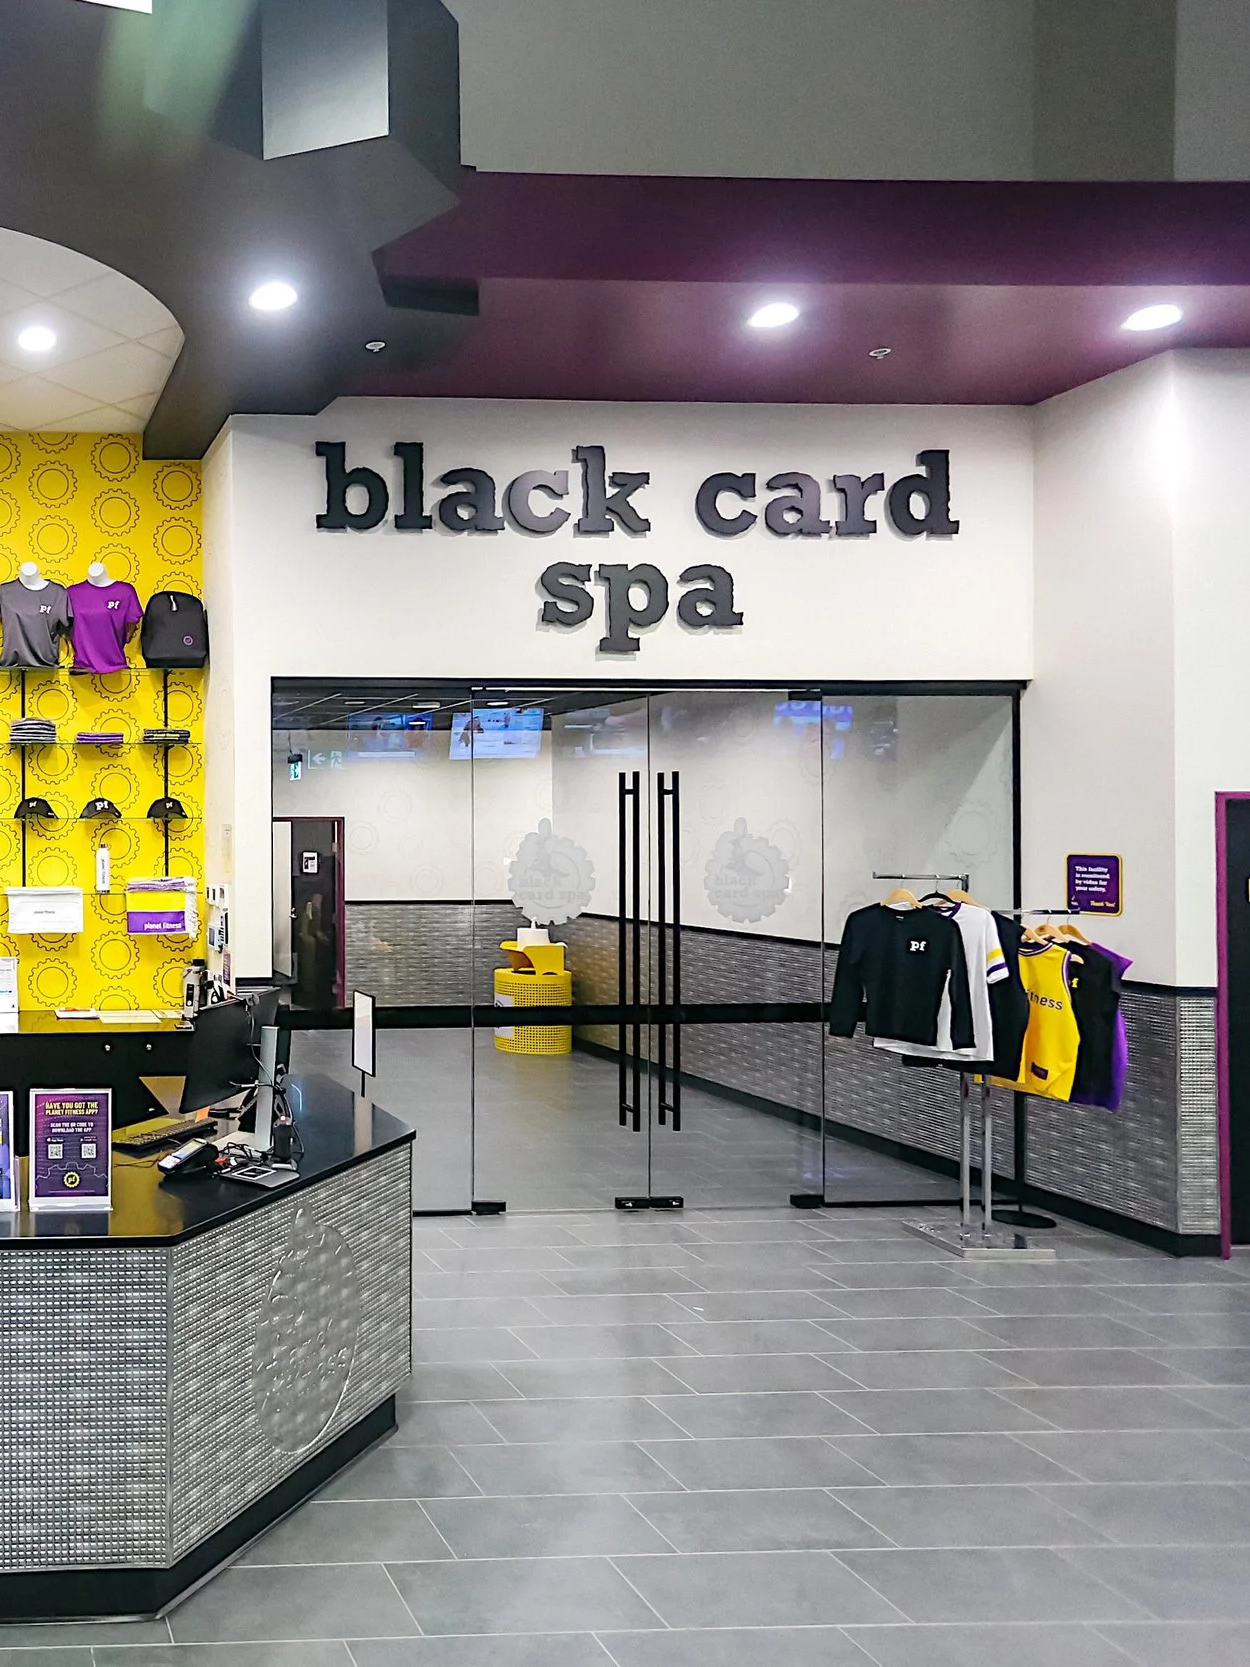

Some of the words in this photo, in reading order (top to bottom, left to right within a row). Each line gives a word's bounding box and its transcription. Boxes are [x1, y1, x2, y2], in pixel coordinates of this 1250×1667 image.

[315, 440, 651, 533] black
[694, 448, 960, 538] card
[38, 605, 52, 614] pf
[107, 600, 121, 610] pf
[537, 560, 745, 654] spa
[94, 800, 110, 811] pf
[165, 801, 174, 809] pf
[143, 921, 162, 931] planet
[162, 921, 182, 929] fitness
[909, 940, 927, 952] pf
[1026, 988, 1064, 1011] itness
[45, 1102, 61, 1110] HAVE
[62, 1102, 74, 1110] YOU
[87, 1101, 99, 1109] THE
